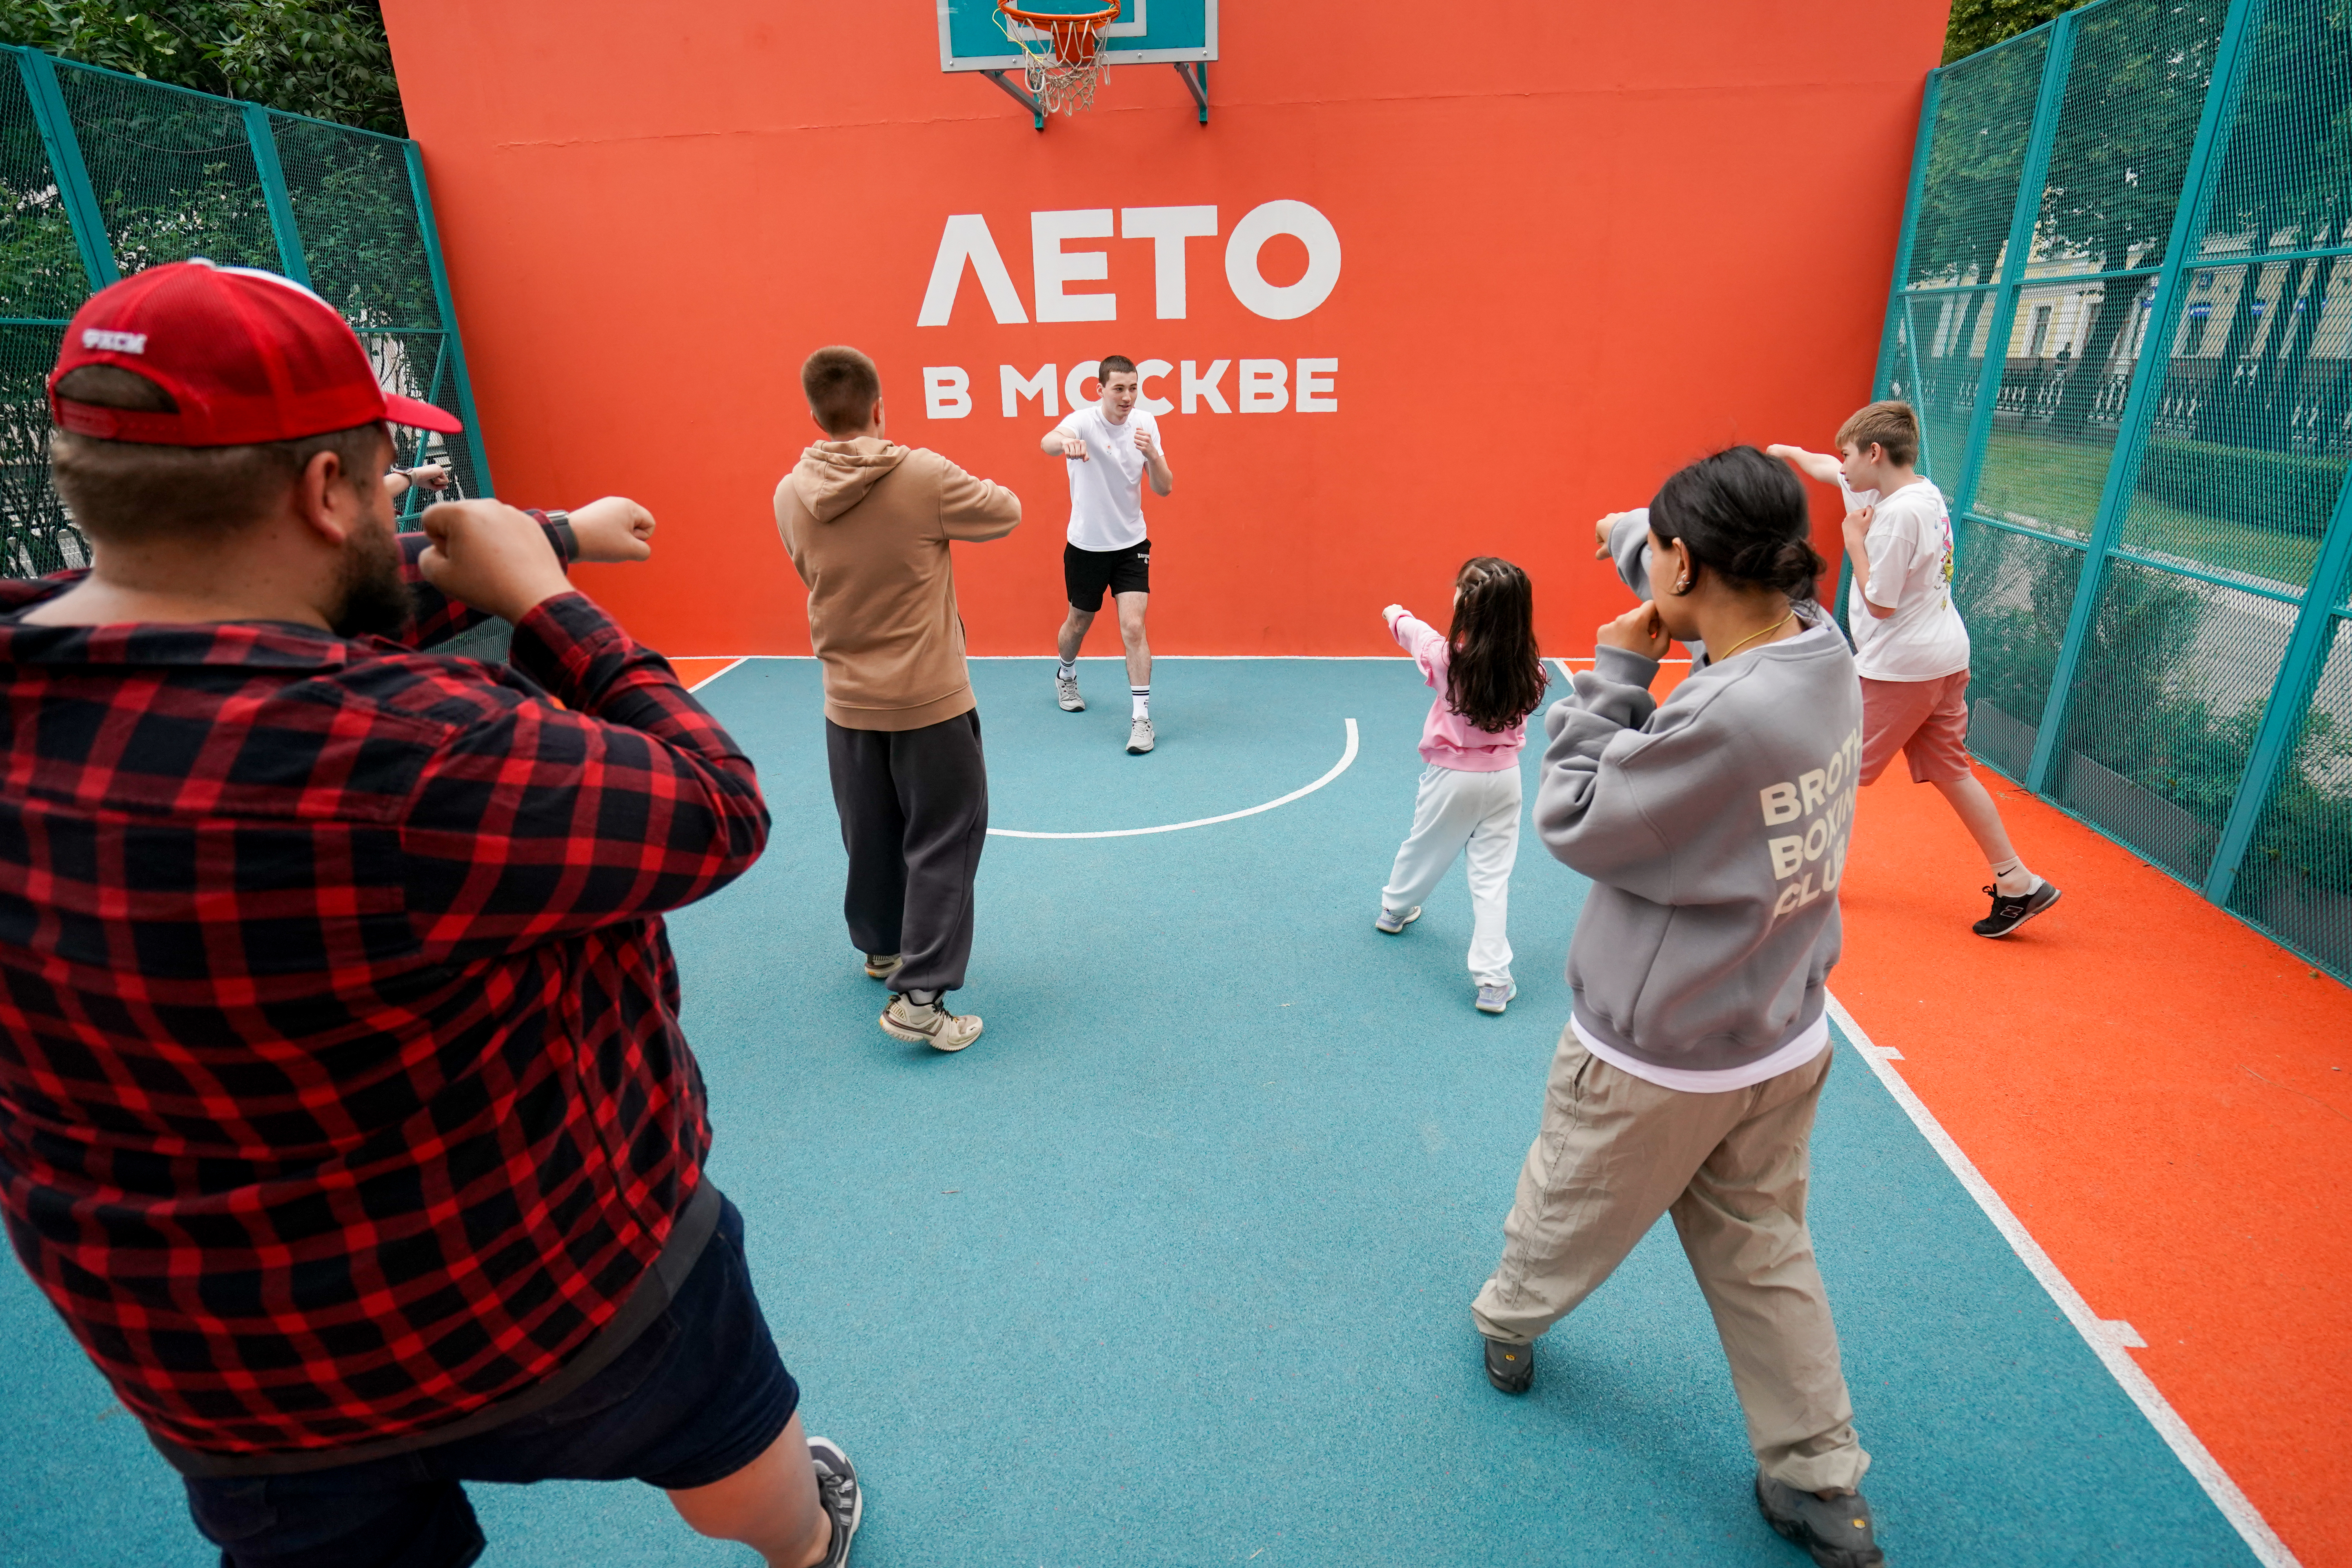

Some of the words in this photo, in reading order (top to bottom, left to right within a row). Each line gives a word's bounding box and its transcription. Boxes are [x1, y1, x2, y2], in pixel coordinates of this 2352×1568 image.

[917, 199, 1342, 327] ЛЕТО
[923, 366, 972, 419] В
[1774, 833, 1846, 918] CLUB
